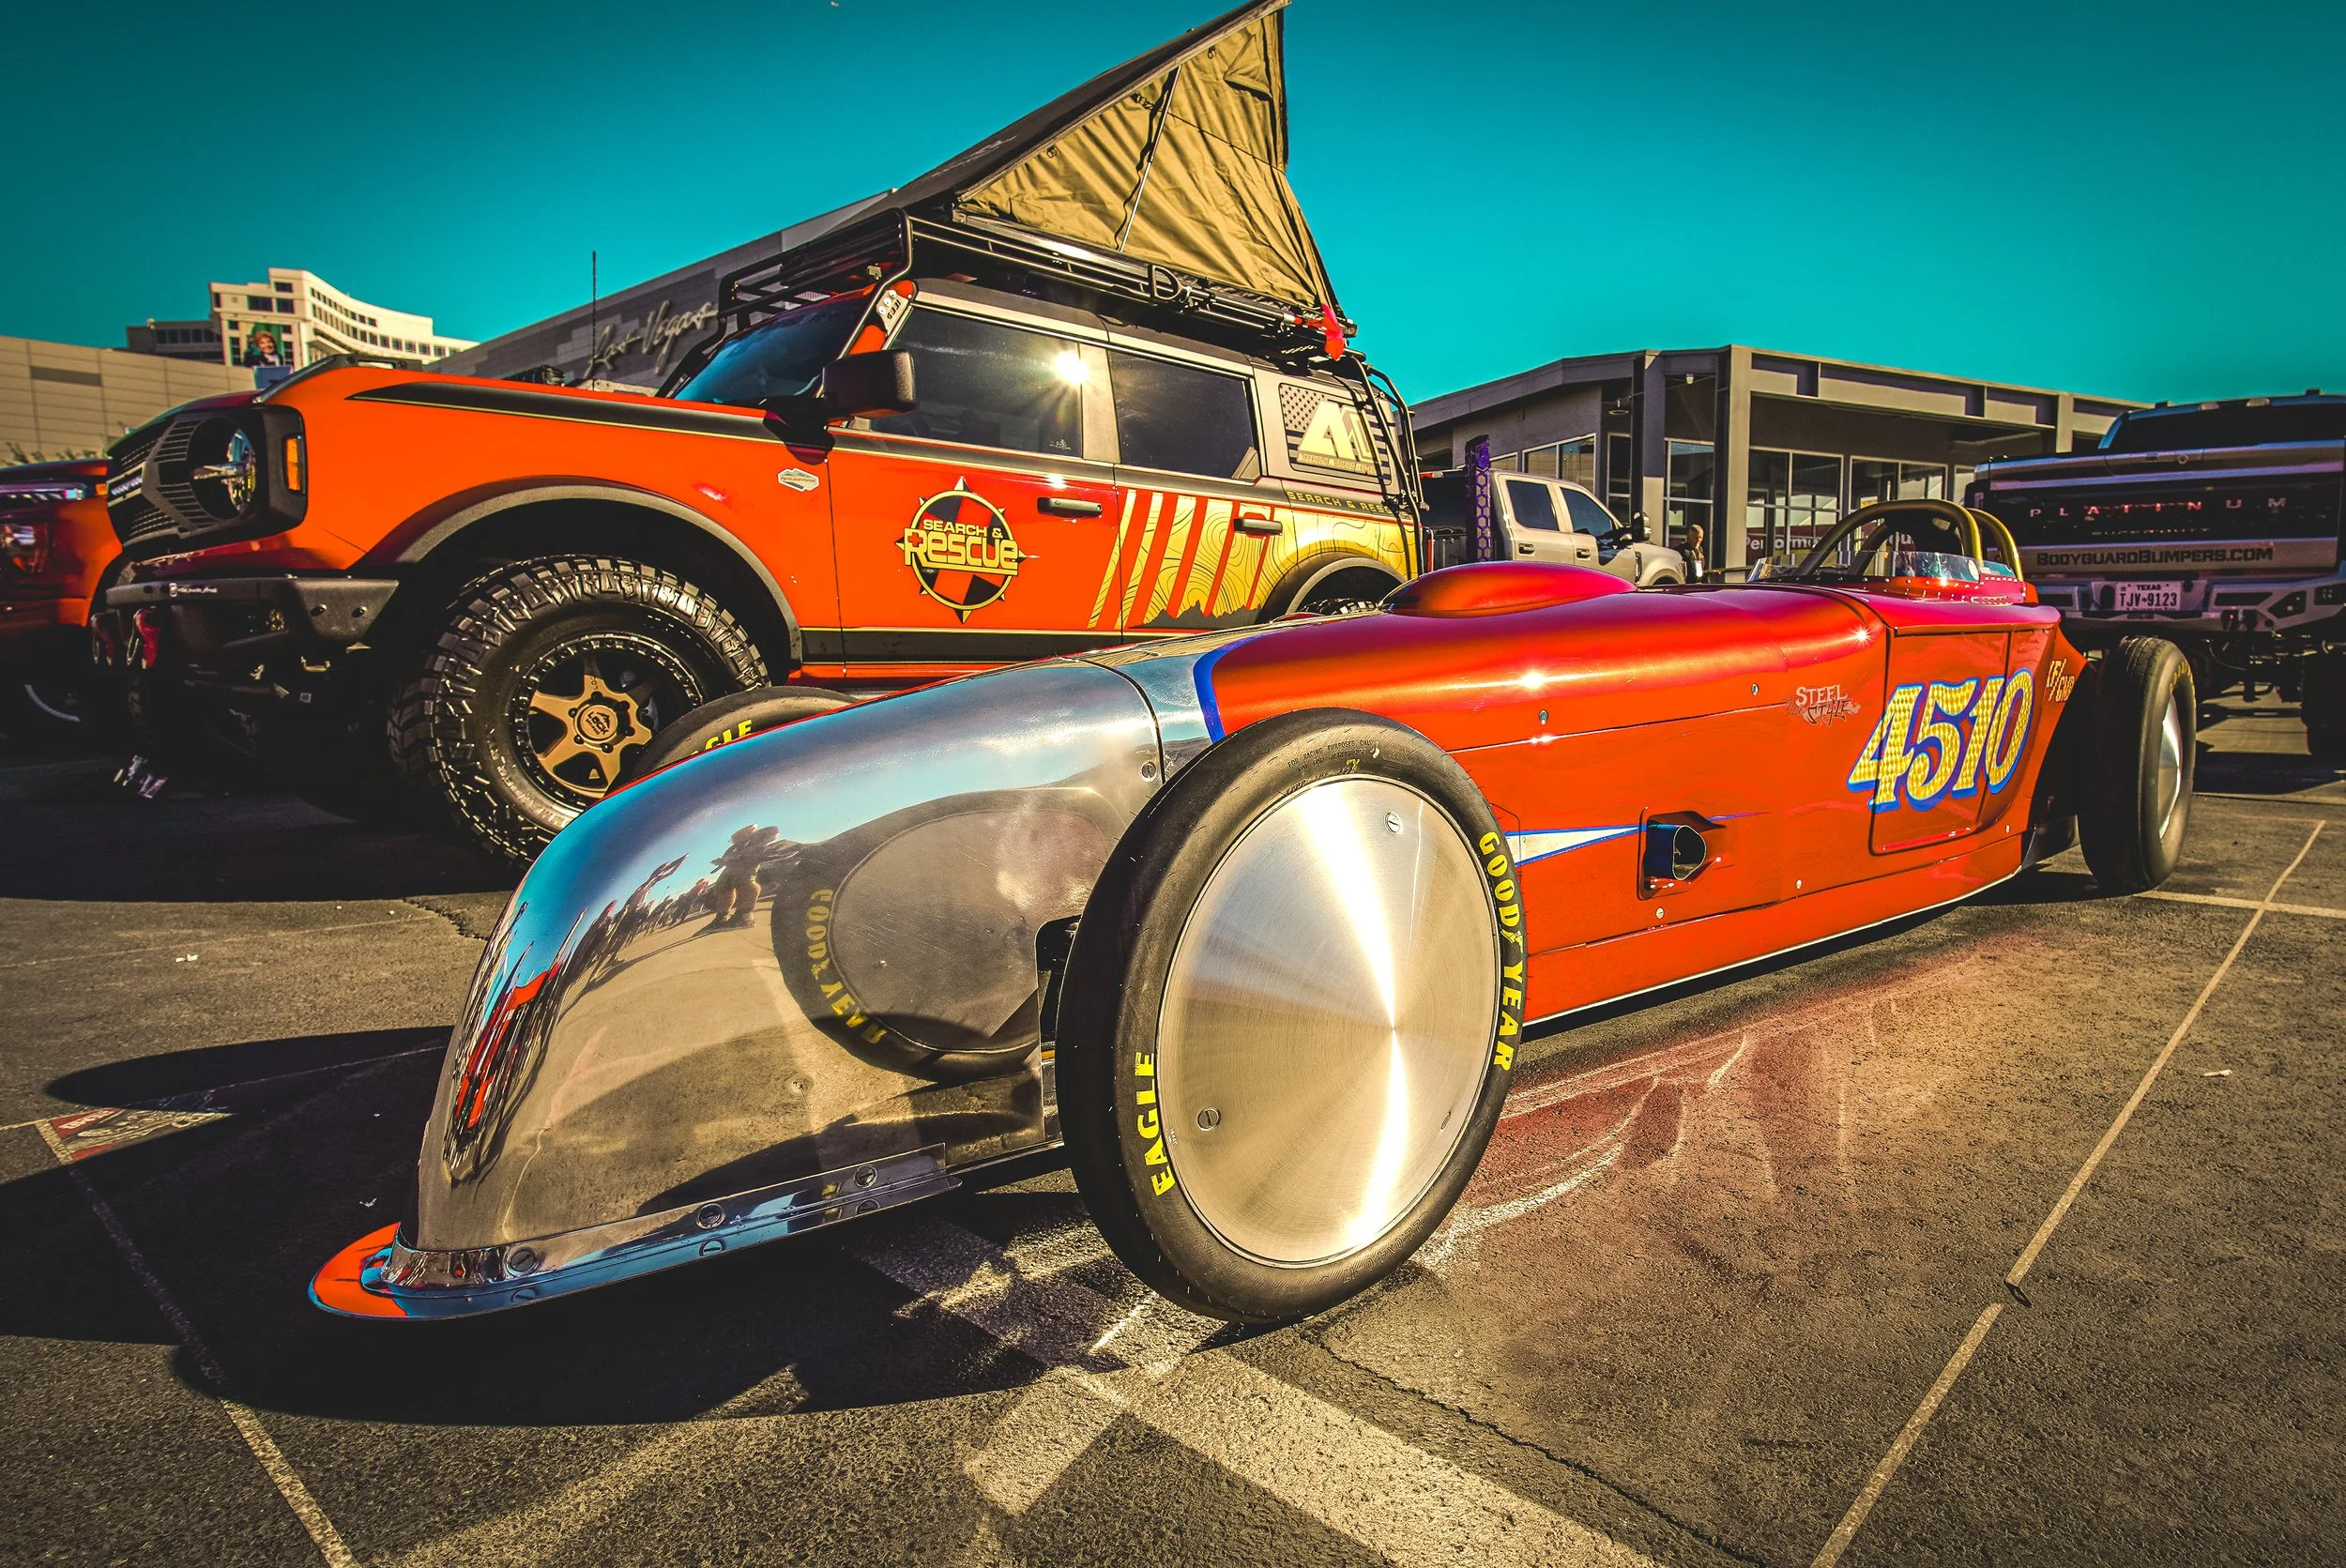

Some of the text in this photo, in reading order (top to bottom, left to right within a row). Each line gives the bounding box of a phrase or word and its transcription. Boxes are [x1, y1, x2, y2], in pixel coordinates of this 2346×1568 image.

[583, 299, 719, 378] Las Vegas
[1287, 490, 1342, 507] SEARCH
[1347, 500, 1357, 510] &
[2029, 497, 2287, 518] PLATINUM
[922, 519, 1004, 539] SEARCH &
[1795, 684, 1848, 708] STEEL
[1806, 698, 1853, 727] STYLE
[1287, 738, 1373, 769] FOR RACING PURPOSES ONLY
[1846, 667, 2034, 814] 4510
[1135, 1051, 1176, 1196] EAGLE
